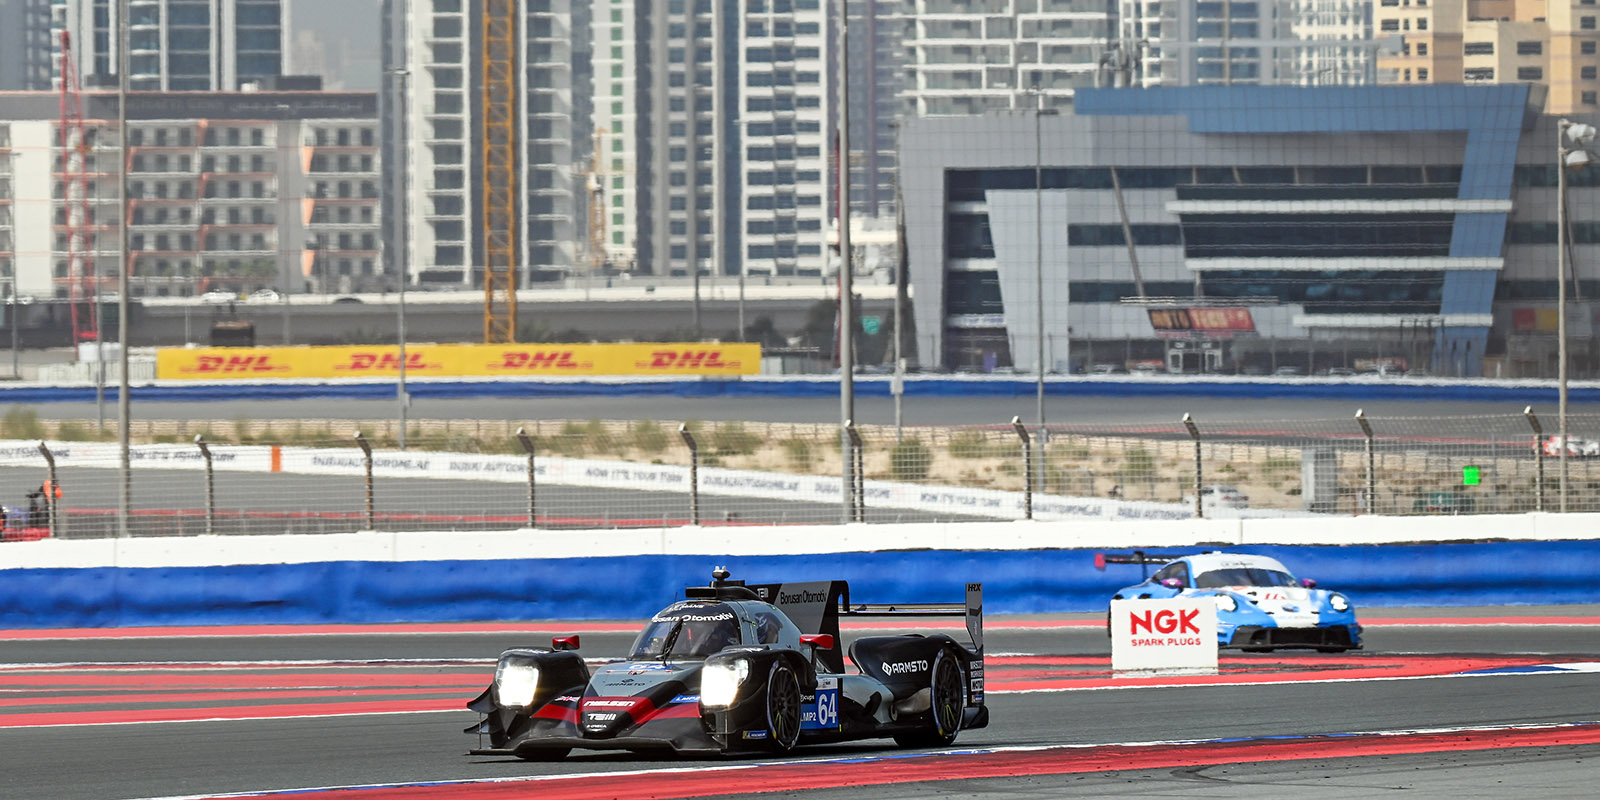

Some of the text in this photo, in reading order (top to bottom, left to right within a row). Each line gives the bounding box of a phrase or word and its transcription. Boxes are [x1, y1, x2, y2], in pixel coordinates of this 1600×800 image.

[198, 356, 273, 372] DHL
[350, 353, 427, 370] DHL
[502, 351, 578, 369] DHL
[651, 351, 726, 369] DHL
[968, 583, 981, 592] HRX
[780, 589, 827, 605] Borusan Otomotiv
[681, 612, 733, 622] Otomotiv
[1130, 608, 1200, 635] NGK
[1131, 637, 1201, 647] SPARK PLUGS
[892, 660, 928, 674] ARMSTO
[818, 693, 837, 725] 64
